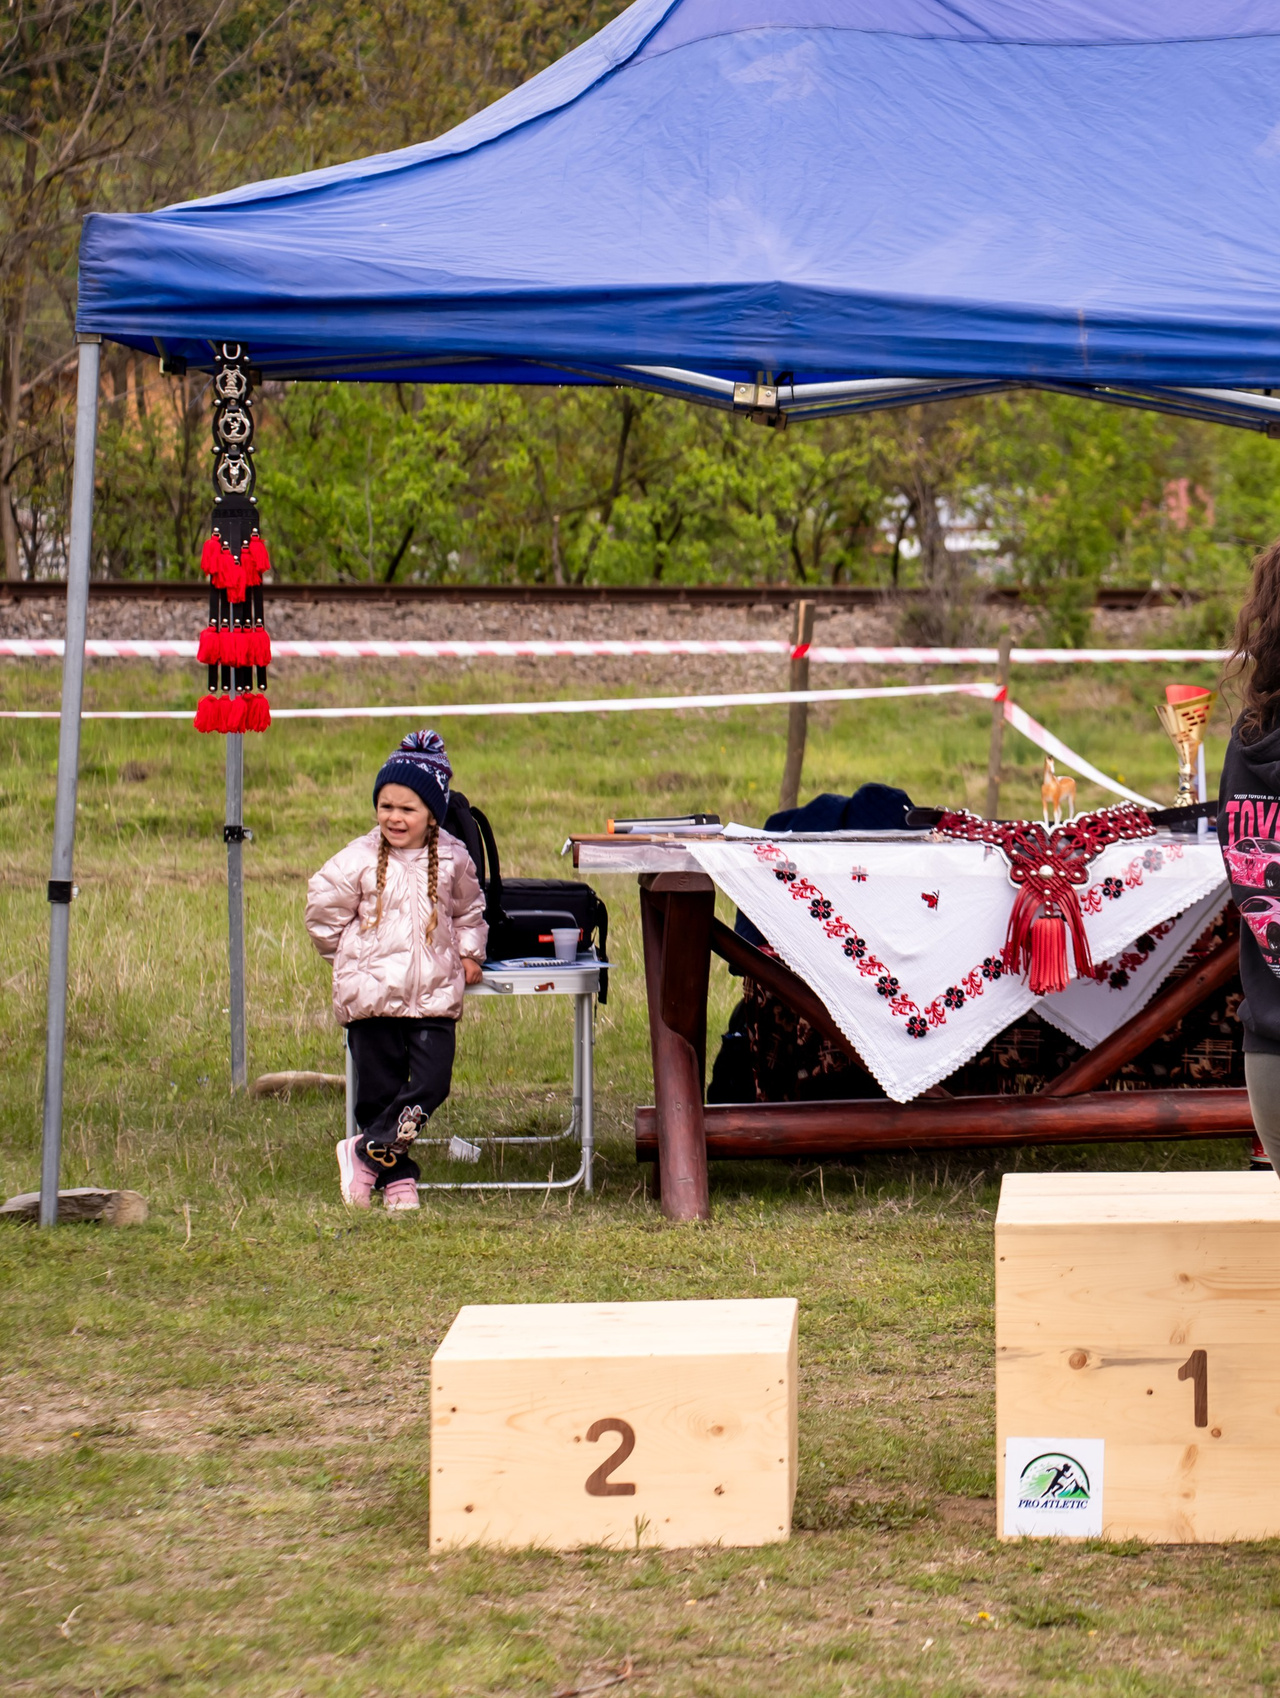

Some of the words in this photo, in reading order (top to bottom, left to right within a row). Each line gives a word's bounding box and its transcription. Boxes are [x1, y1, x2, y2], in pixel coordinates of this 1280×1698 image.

[1178, 1349, 1208, 1427] 1
[585, 1418, 636, 1496] 2
[1018, 1499, 1040, 1509] PRO
[1041, 1499, 1089, 1509] ATLETIC
